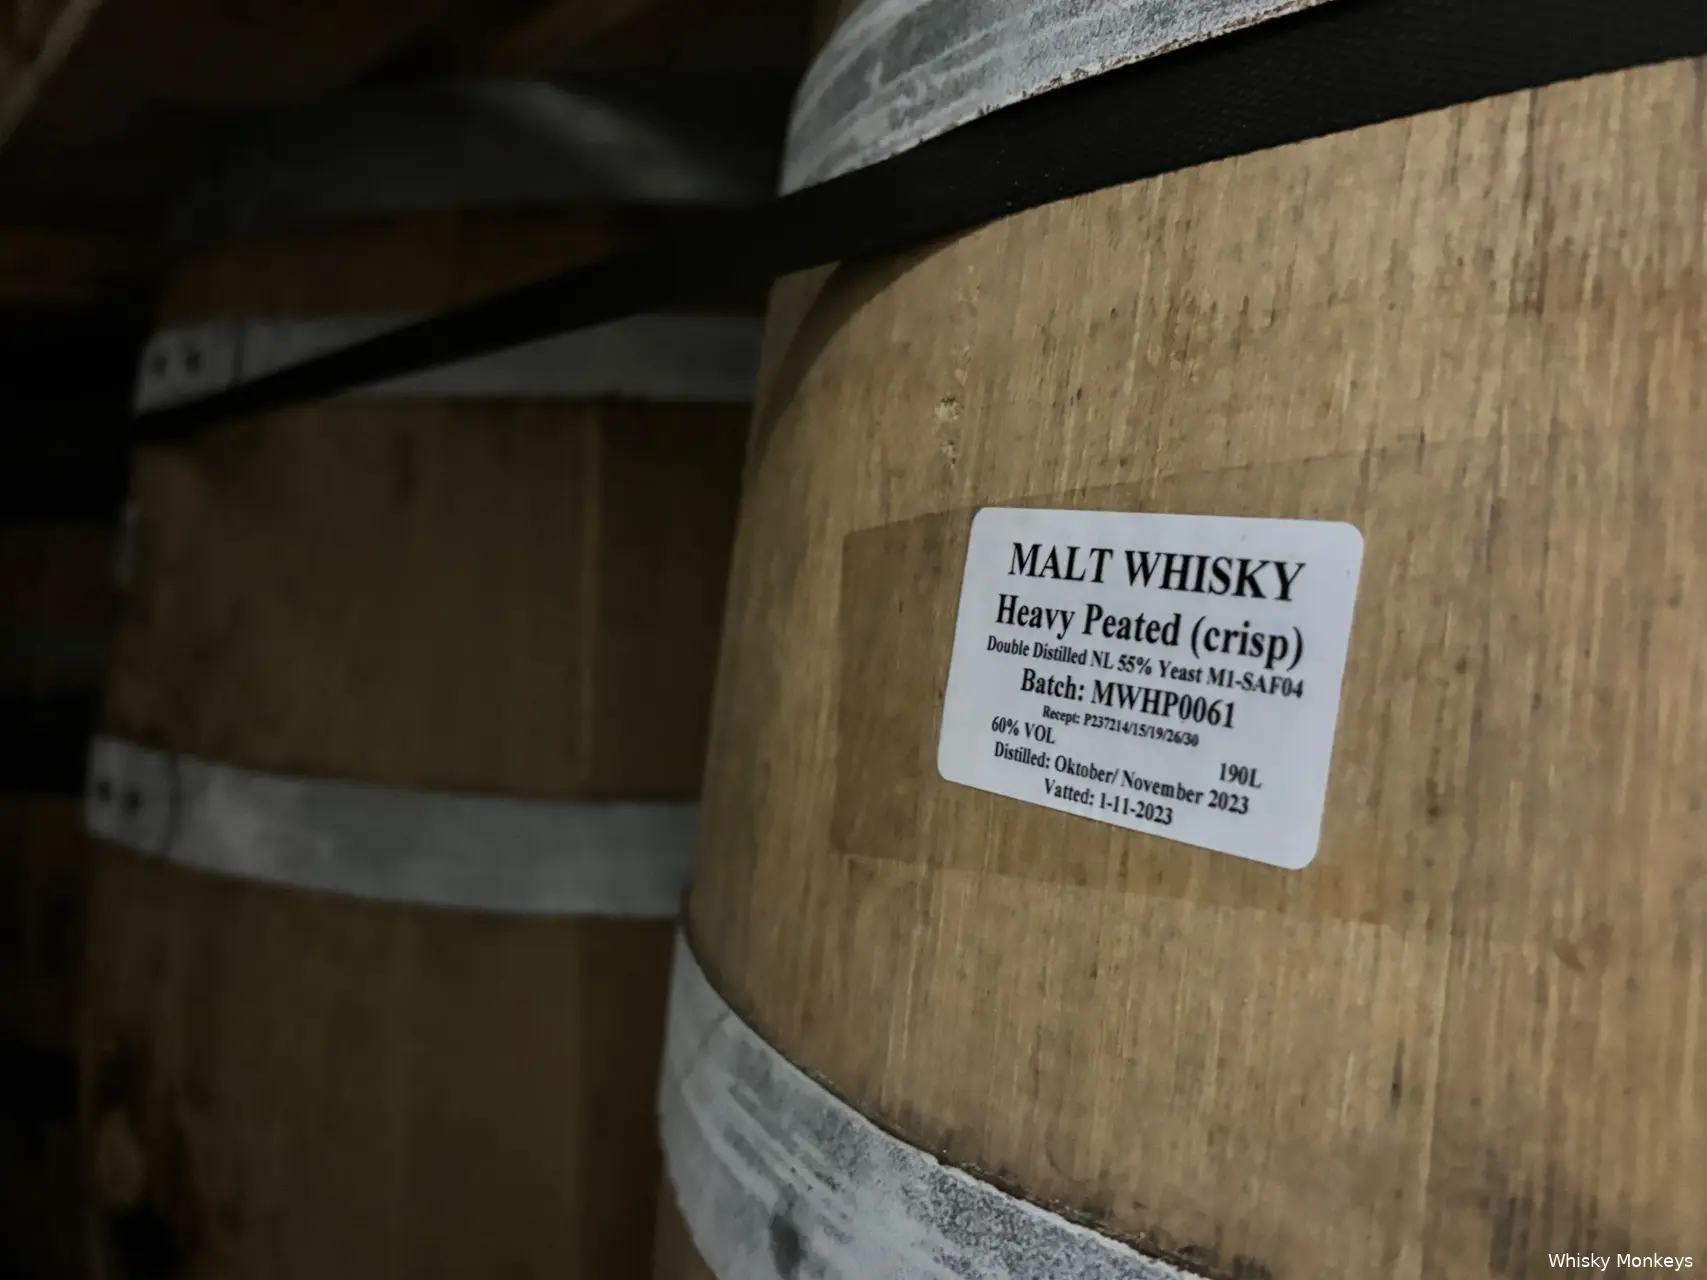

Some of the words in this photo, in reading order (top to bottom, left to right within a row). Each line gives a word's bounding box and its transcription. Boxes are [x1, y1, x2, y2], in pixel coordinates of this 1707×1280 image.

[1008, 541, 1113, 584] MALT
[1125, 550, 1306, 602] WHISKY
[995, 593, 1075, 640] Heavy
[1081, 603, 1181, 647] Peated
[1191, 616, 1304, 672] (crisp)
[987, 635, 1030, 657] Double
[1032, 642, 1087, 667] Distilled
[1090, 654, 1114, 670] NL
[1117, 656, 1152, 676] 55%
[1158, 660, 1204, 684] Yeast
[1206, 666, 1304, 699] M1-SAF04
[1020, 668, 1085, 701] Batch:
[1091, 679, 1236, 729] MWHP0061
[1042, 705, 1080, 725] Recept:
[991, 716, 1020, 737] 60%
[1023, 724, 1056, 745] VOL
[994, 741, 1051, 769] Distilled:
[1054, 755, 1120, 785] Oktober/
[1121, 769, 1204, 806] November
[1207, 790, 1250, 815] 2023
[1043, 778, 1095, 806] Vatted:
[1099, 793, 1174, 826] 1-11-2023
[1218, 762, 1263, 789] 190L
